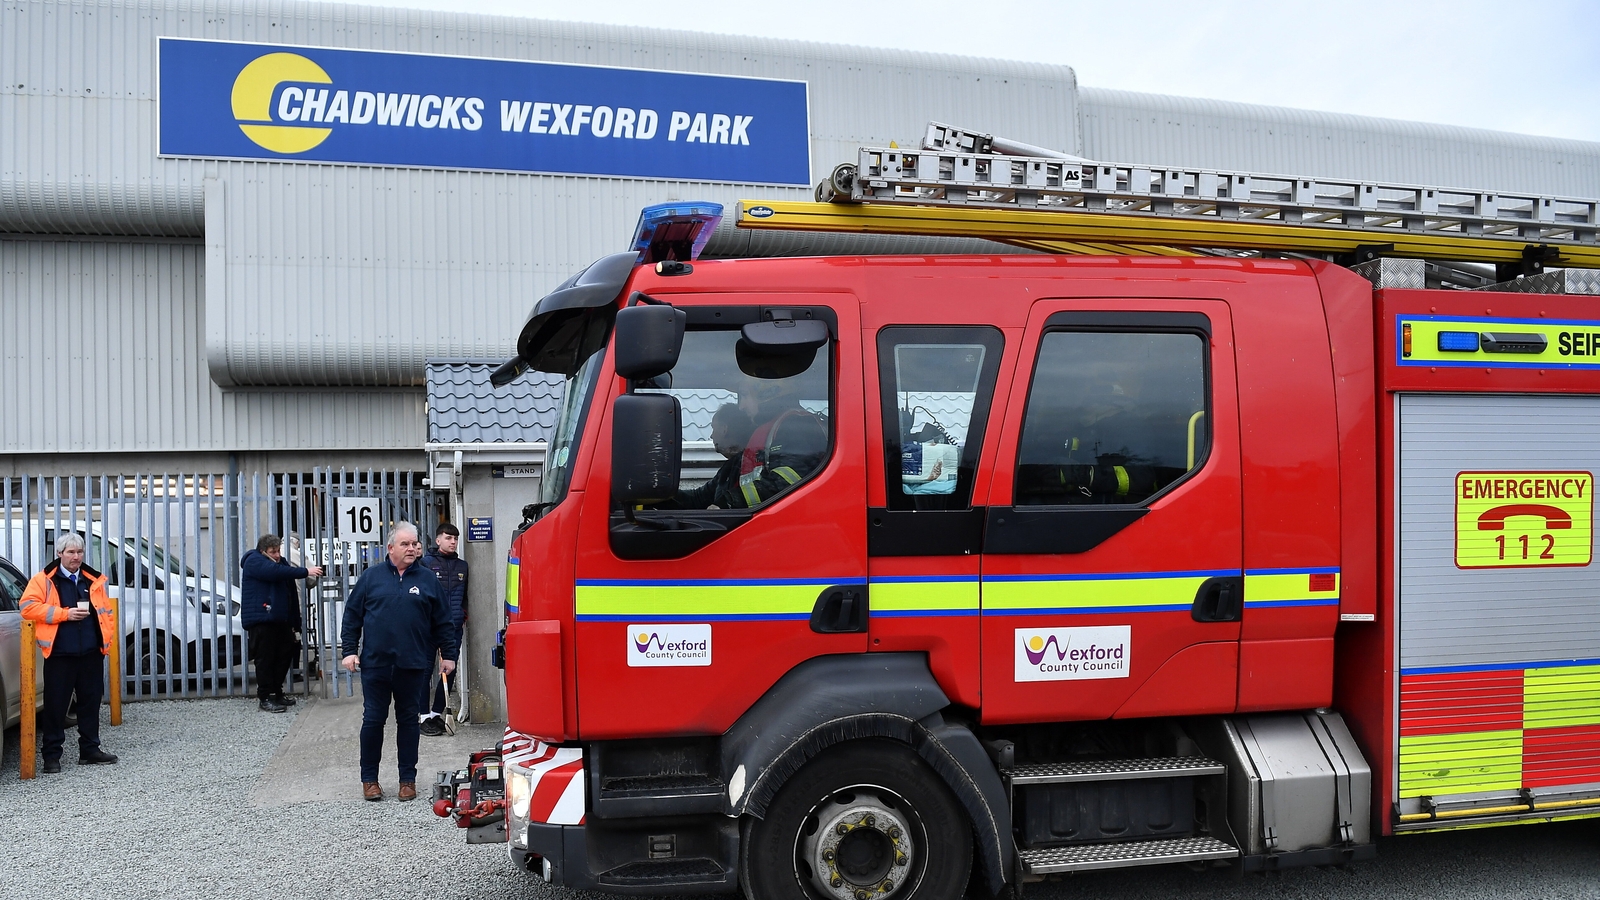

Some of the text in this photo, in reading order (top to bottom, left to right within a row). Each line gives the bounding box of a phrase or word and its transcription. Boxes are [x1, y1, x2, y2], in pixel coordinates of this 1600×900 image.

[278, 87, 754, 146] CHADWICKS WEXFORD PARK
[1065, 171, 1080, 181] AS
[1462, 479, 1587, 499] EMERGENCY
[346, 506, 372, 534] 16
[633, 632, 707, 653] Wexford
[1022, 635, 1124, 665] Wexford
[645, 651, 674, 659] County
[1039, 660, 1123, 674] County Council
